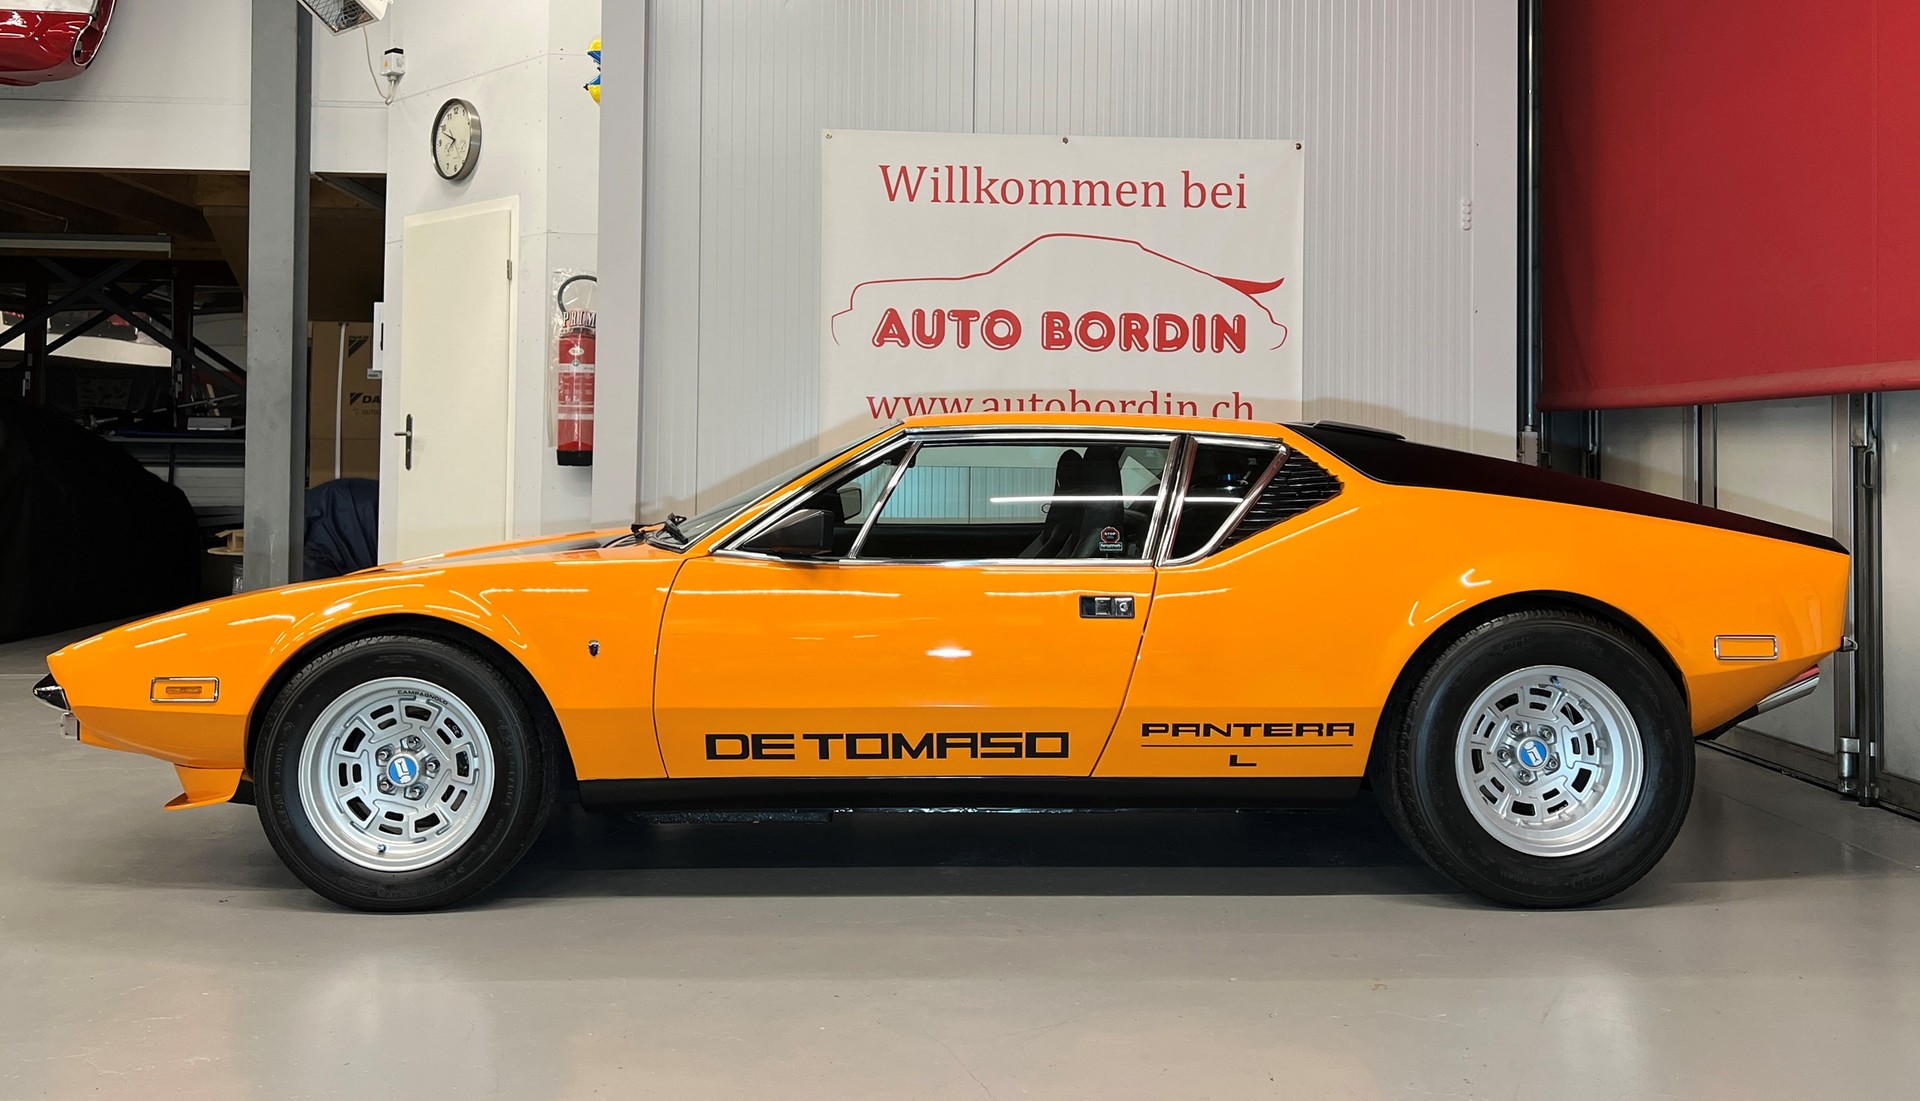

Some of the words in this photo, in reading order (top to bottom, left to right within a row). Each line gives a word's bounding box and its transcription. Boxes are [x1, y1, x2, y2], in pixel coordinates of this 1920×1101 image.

[453, 106, 459, 114] 12
[879, 164, 1166, 208] Willkommen
[1181, 169, 1247, 209] bei
[872, 307, 1022, 350] AUTO
[1041, 310, 1247, 354] BORDIN
[866, 389, 1253, 420] wwwautobordinch
[397, 690, 449, 706] CAMPAGNOLO
[1141, 723, 1355, 737] PANTERA
[705, 733, 796, 760] DE
[802, 731, 1069, 760] TOMASO
[1229, 754, 1257, 767] L
